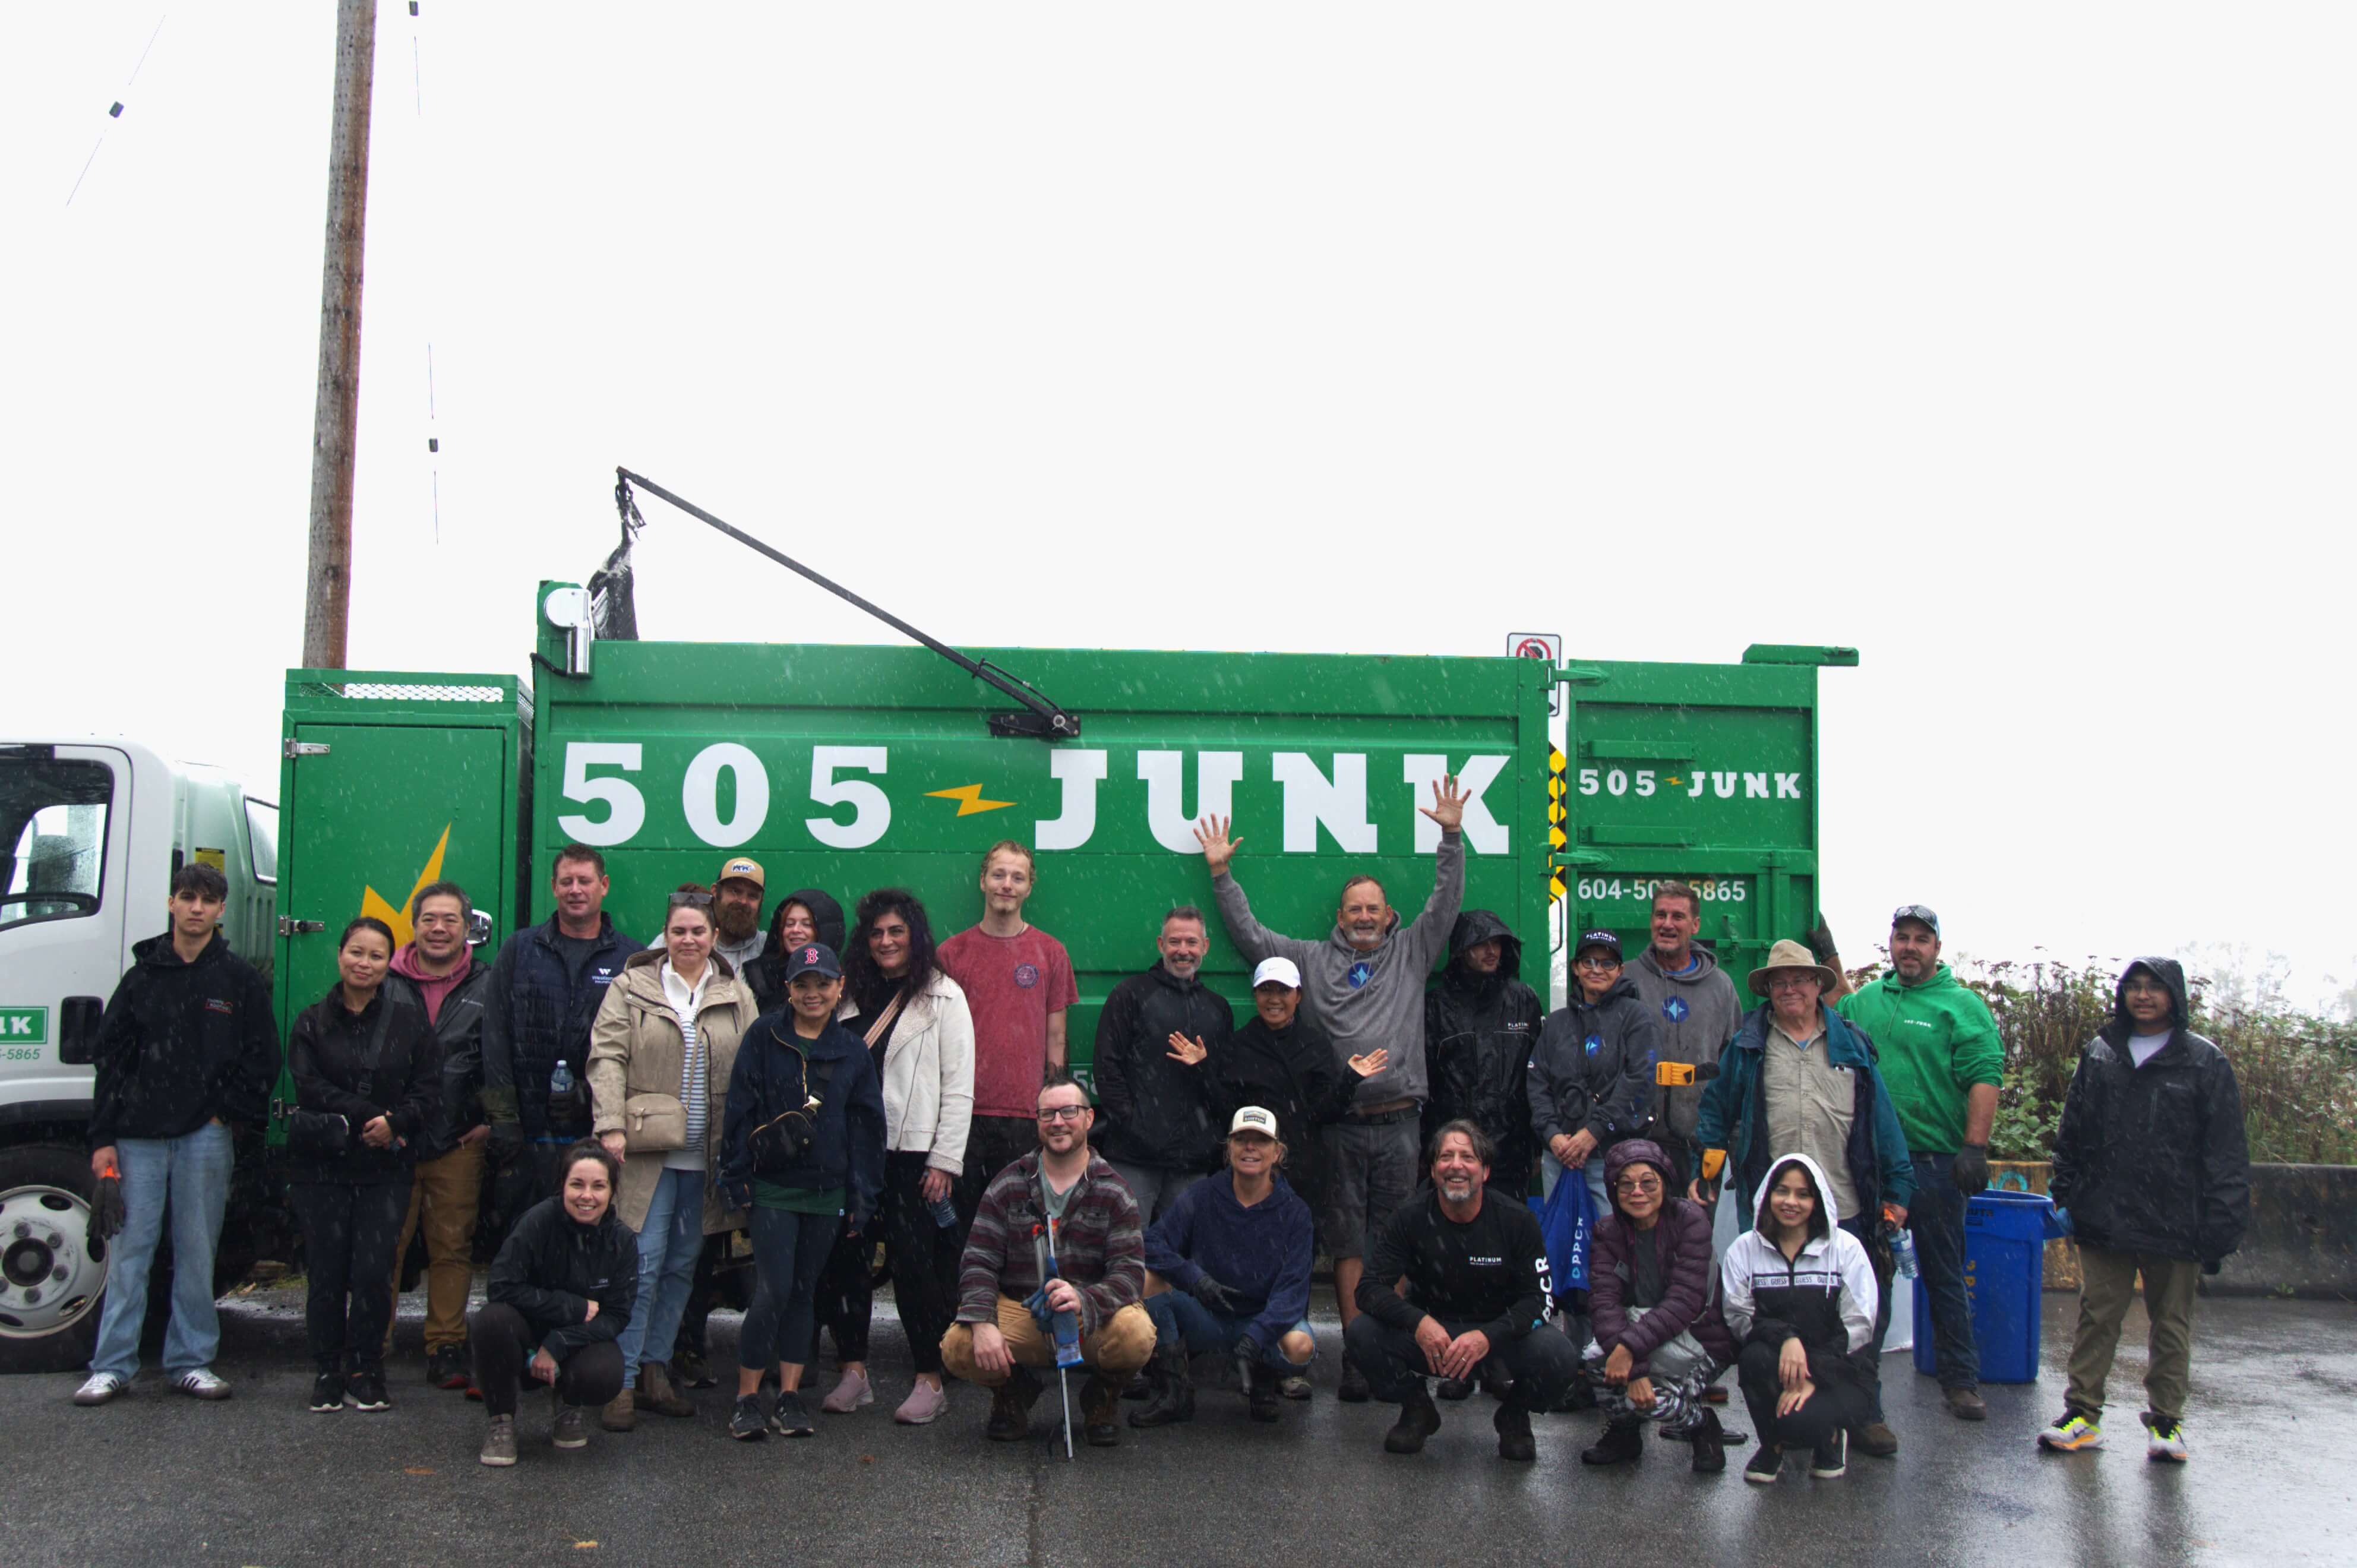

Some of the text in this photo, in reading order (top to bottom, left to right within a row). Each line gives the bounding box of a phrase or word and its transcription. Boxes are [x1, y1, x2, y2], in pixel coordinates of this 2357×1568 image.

[558, 742, 1511, 858] 505 JUNK
[1578, 769, 1801, 799] 505 JUNK
